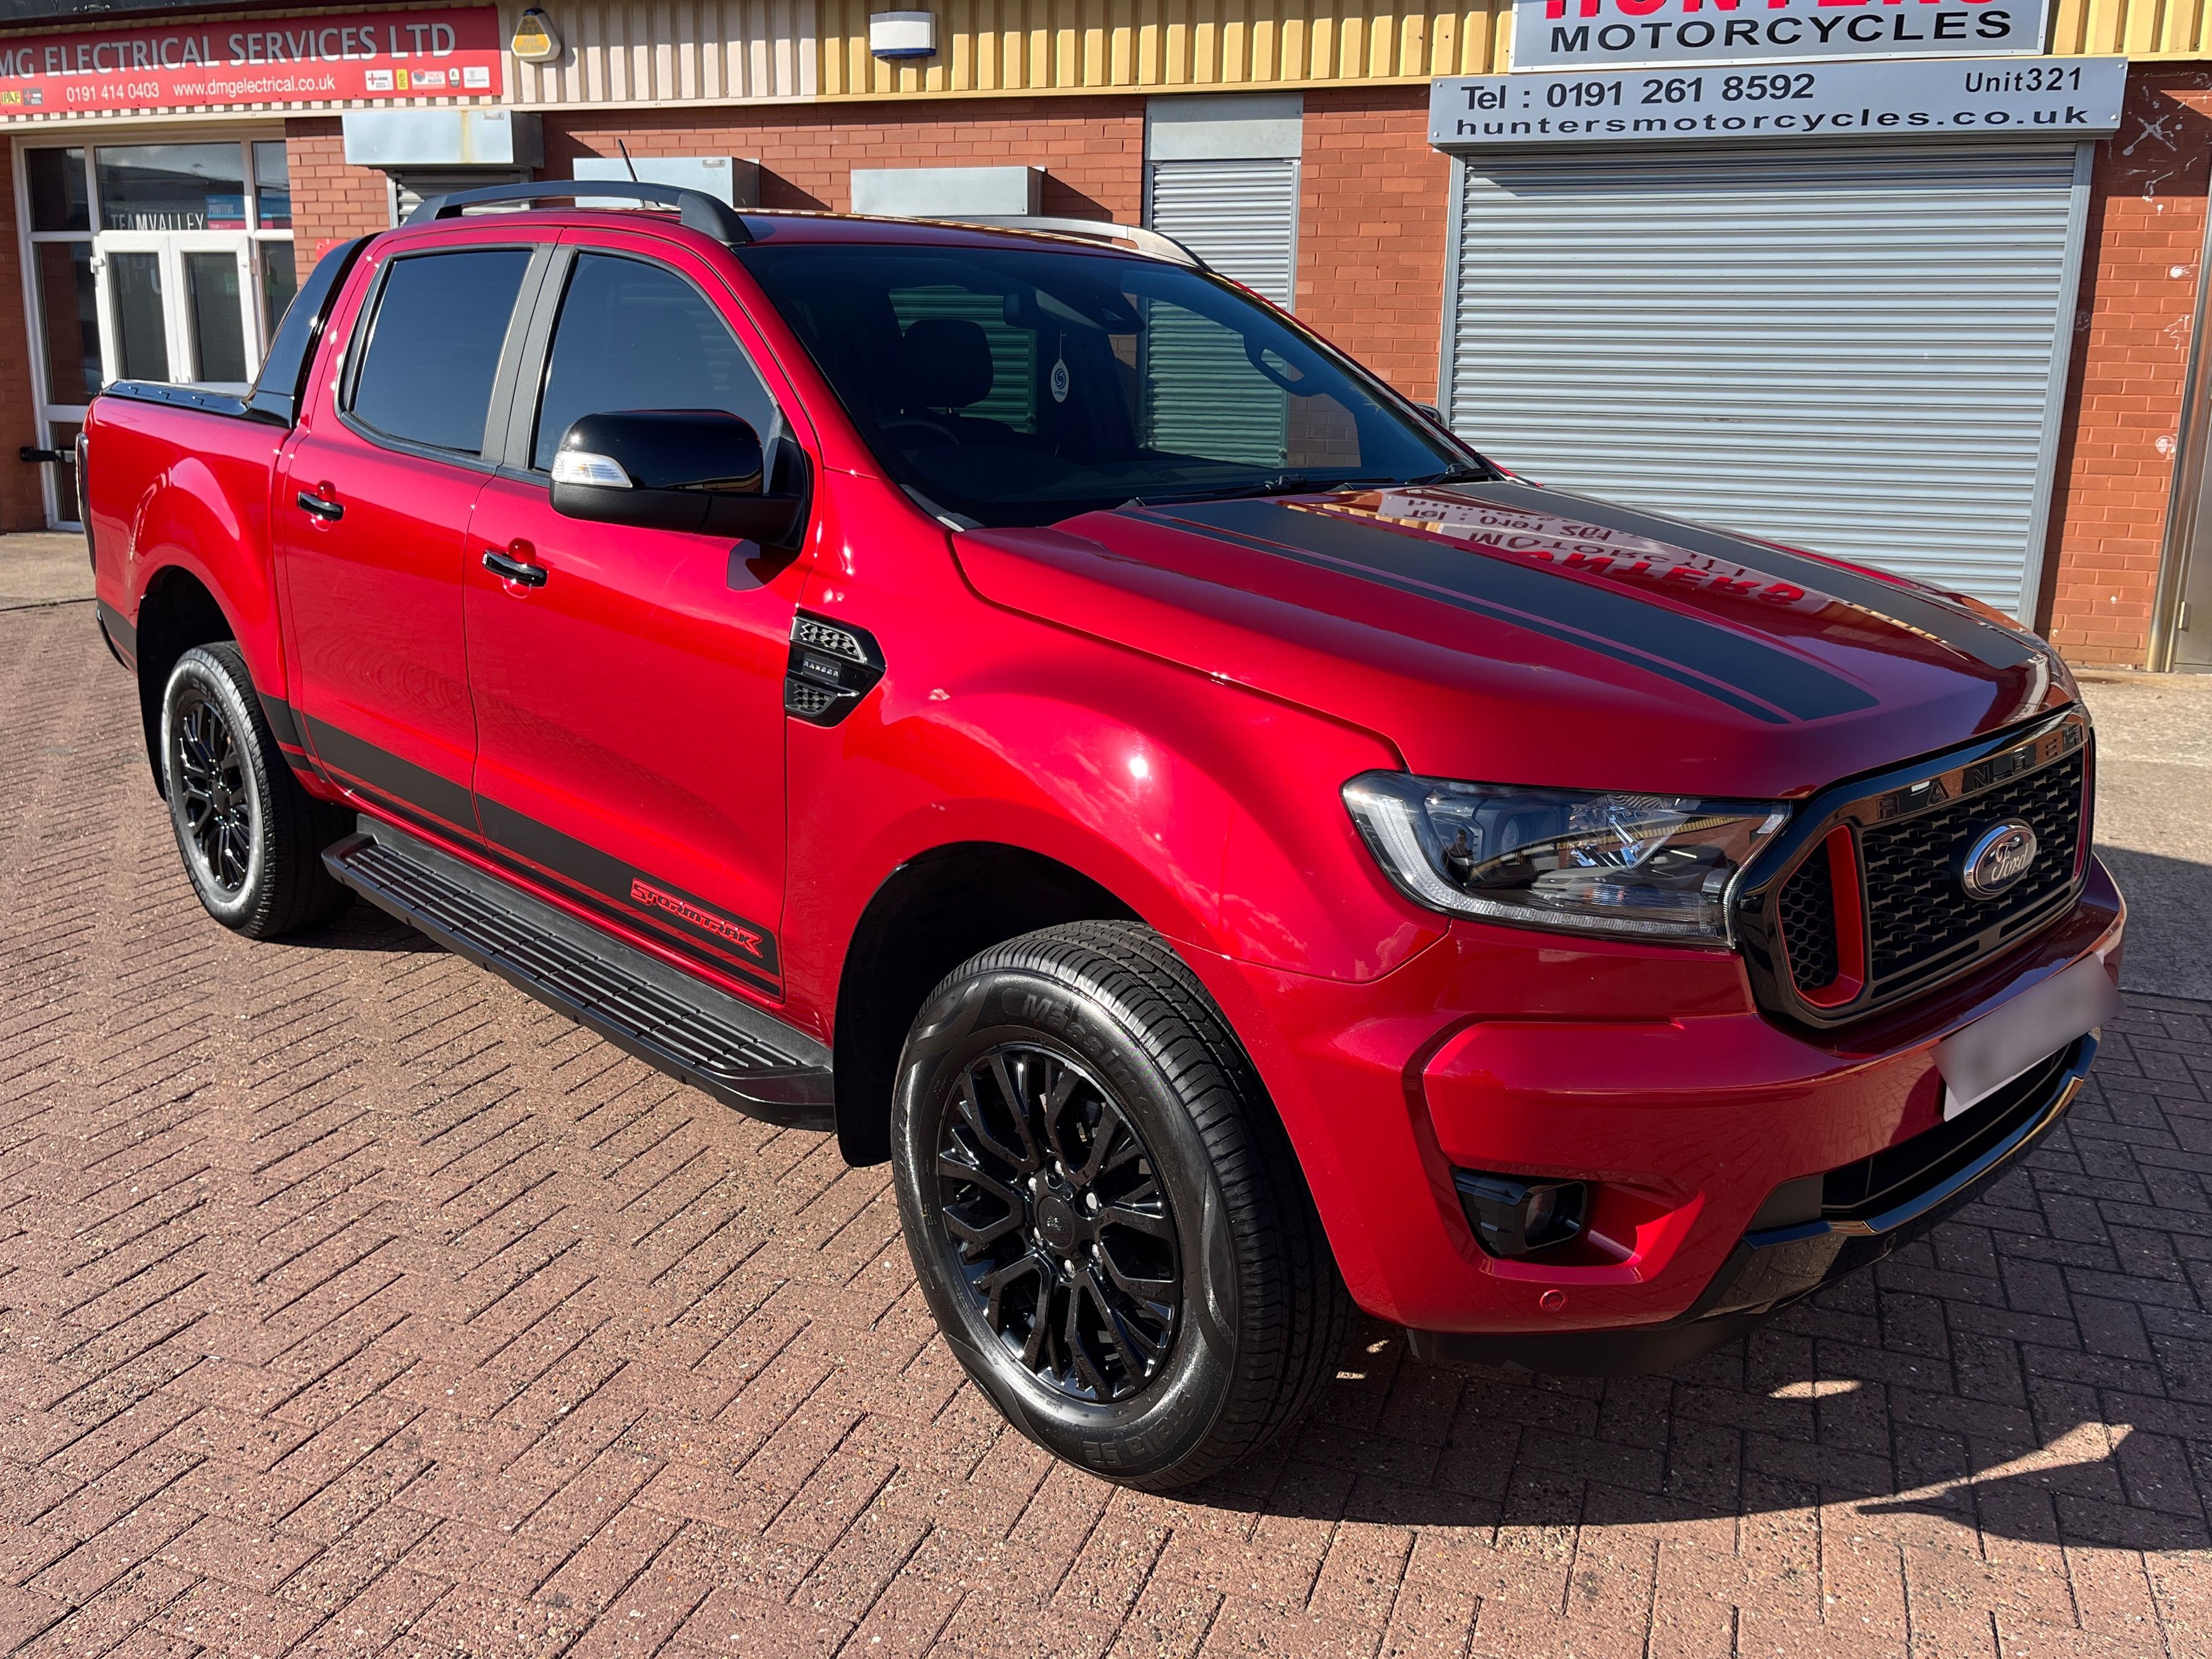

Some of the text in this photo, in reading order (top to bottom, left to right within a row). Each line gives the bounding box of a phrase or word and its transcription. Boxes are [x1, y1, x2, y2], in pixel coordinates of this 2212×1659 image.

[44, 35, 220, 77] ELECTRICAL
[228, 26, 378, 67] SERVICES
[389, 23, 456, 59] LTD
[1550, 11, 2012, 53] MOTORCYCLES
[66, 74, 336, 103] 0191 414 0403 www.dmgelectrical.co.uk
[1461, 85, 1506, 110] Tel
[1547, 80, 1623, 108] 0191
[1641, 77, 1703, 104] 261
[1722, 73, 1815, 101] 8592
[1965, 67, 2082, 93] Unit321
[1456, 106, 2088, 132] huntersmotorcycles.co.uk
[1991, 841, 2028, 882] Ford
